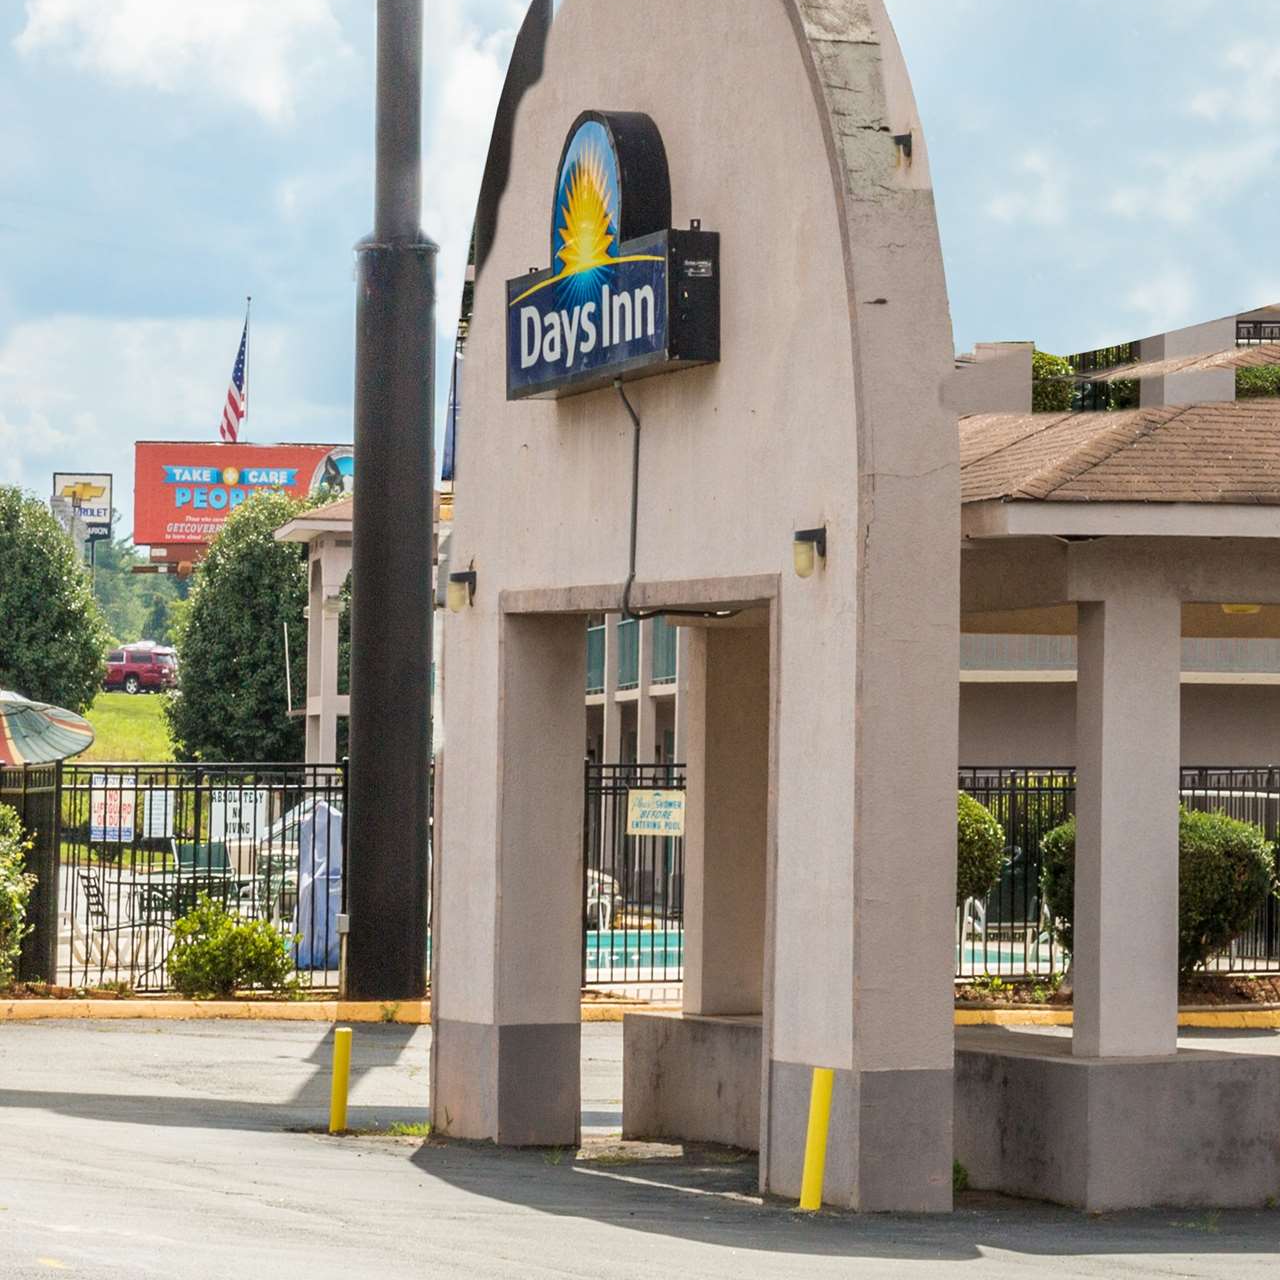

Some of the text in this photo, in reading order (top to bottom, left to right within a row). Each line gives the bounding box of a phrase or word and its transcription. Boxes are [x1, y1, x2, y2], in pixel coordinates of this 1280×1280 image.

[520, 284, 655, 369] Days Inn
[173, 468, 288, 483] TAKE CARE
[175, 487, 284, 512] PEOP
[108, 815, 128, 827] DUY
[640, 810, 672, 820] BEFORE
